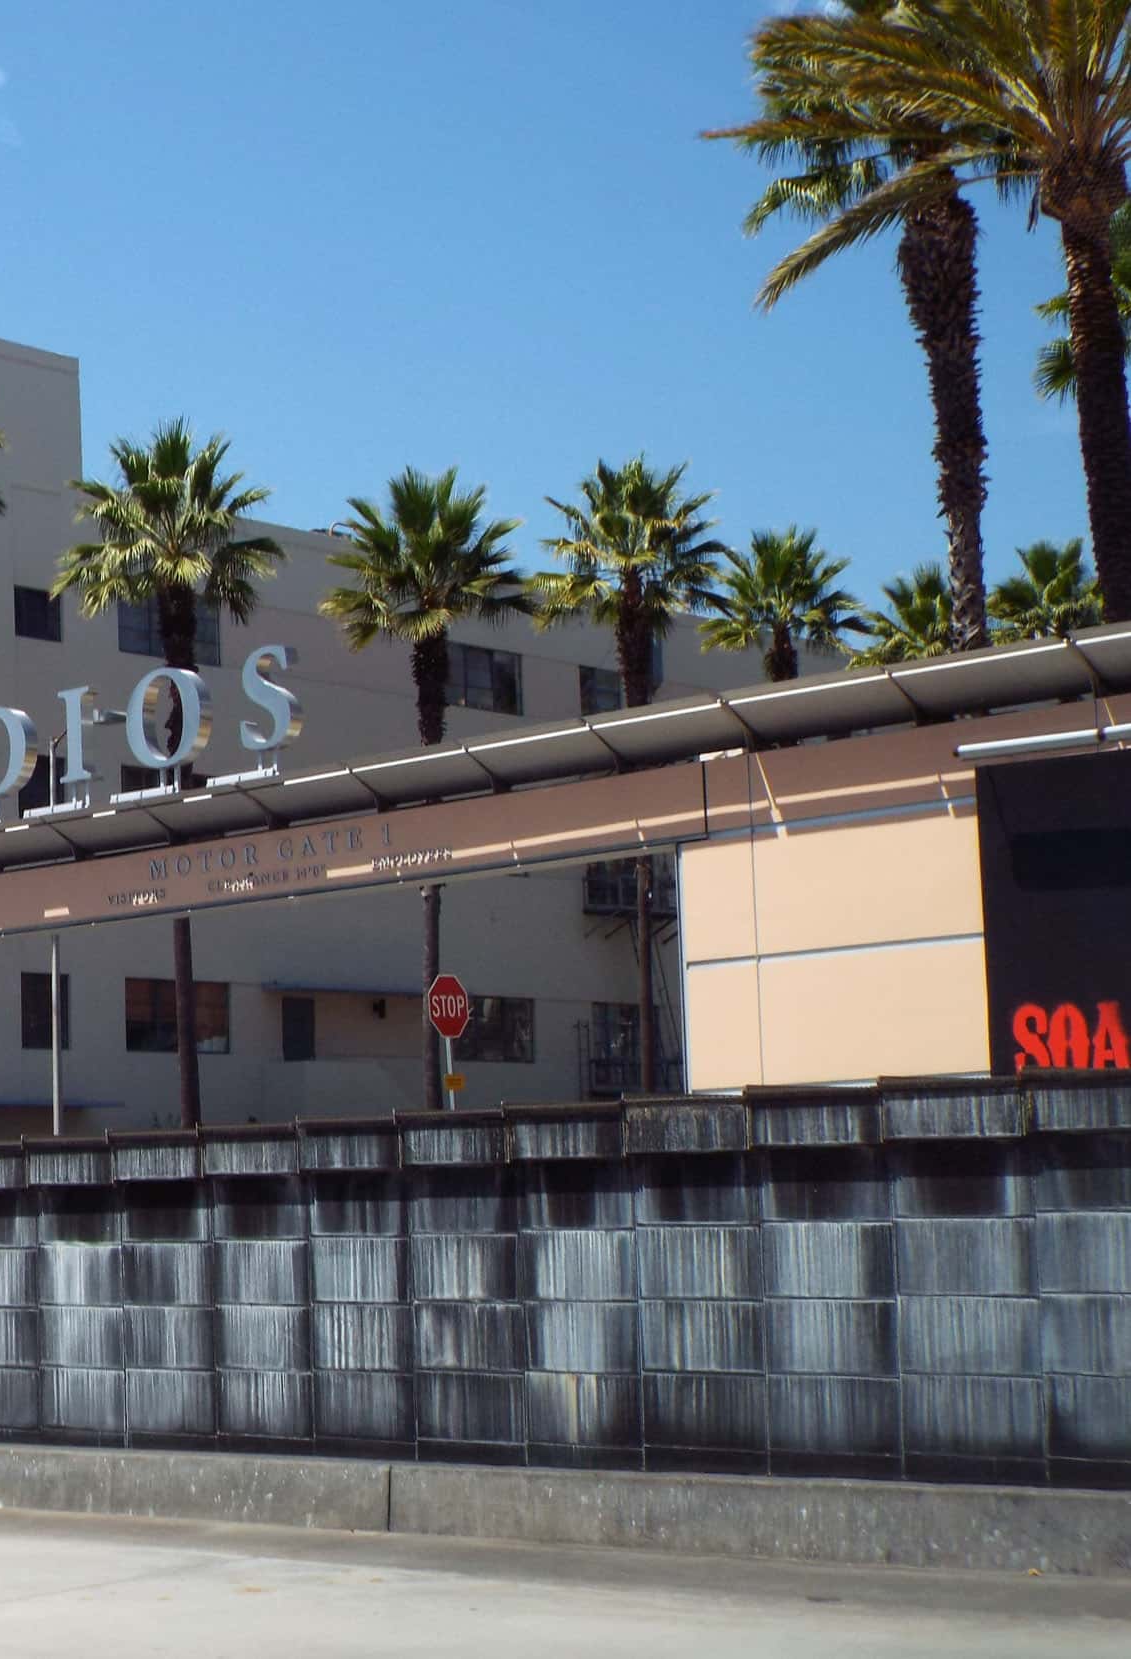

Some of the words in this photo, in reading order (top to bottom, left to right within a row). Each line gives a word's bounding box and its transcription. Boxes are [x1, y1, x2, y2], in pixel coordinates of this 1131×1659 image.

[148, 843, 260, 880] MOTOR
[277, 825, 363, 861] GATE
[431, 994, 465, 1017] STOP
